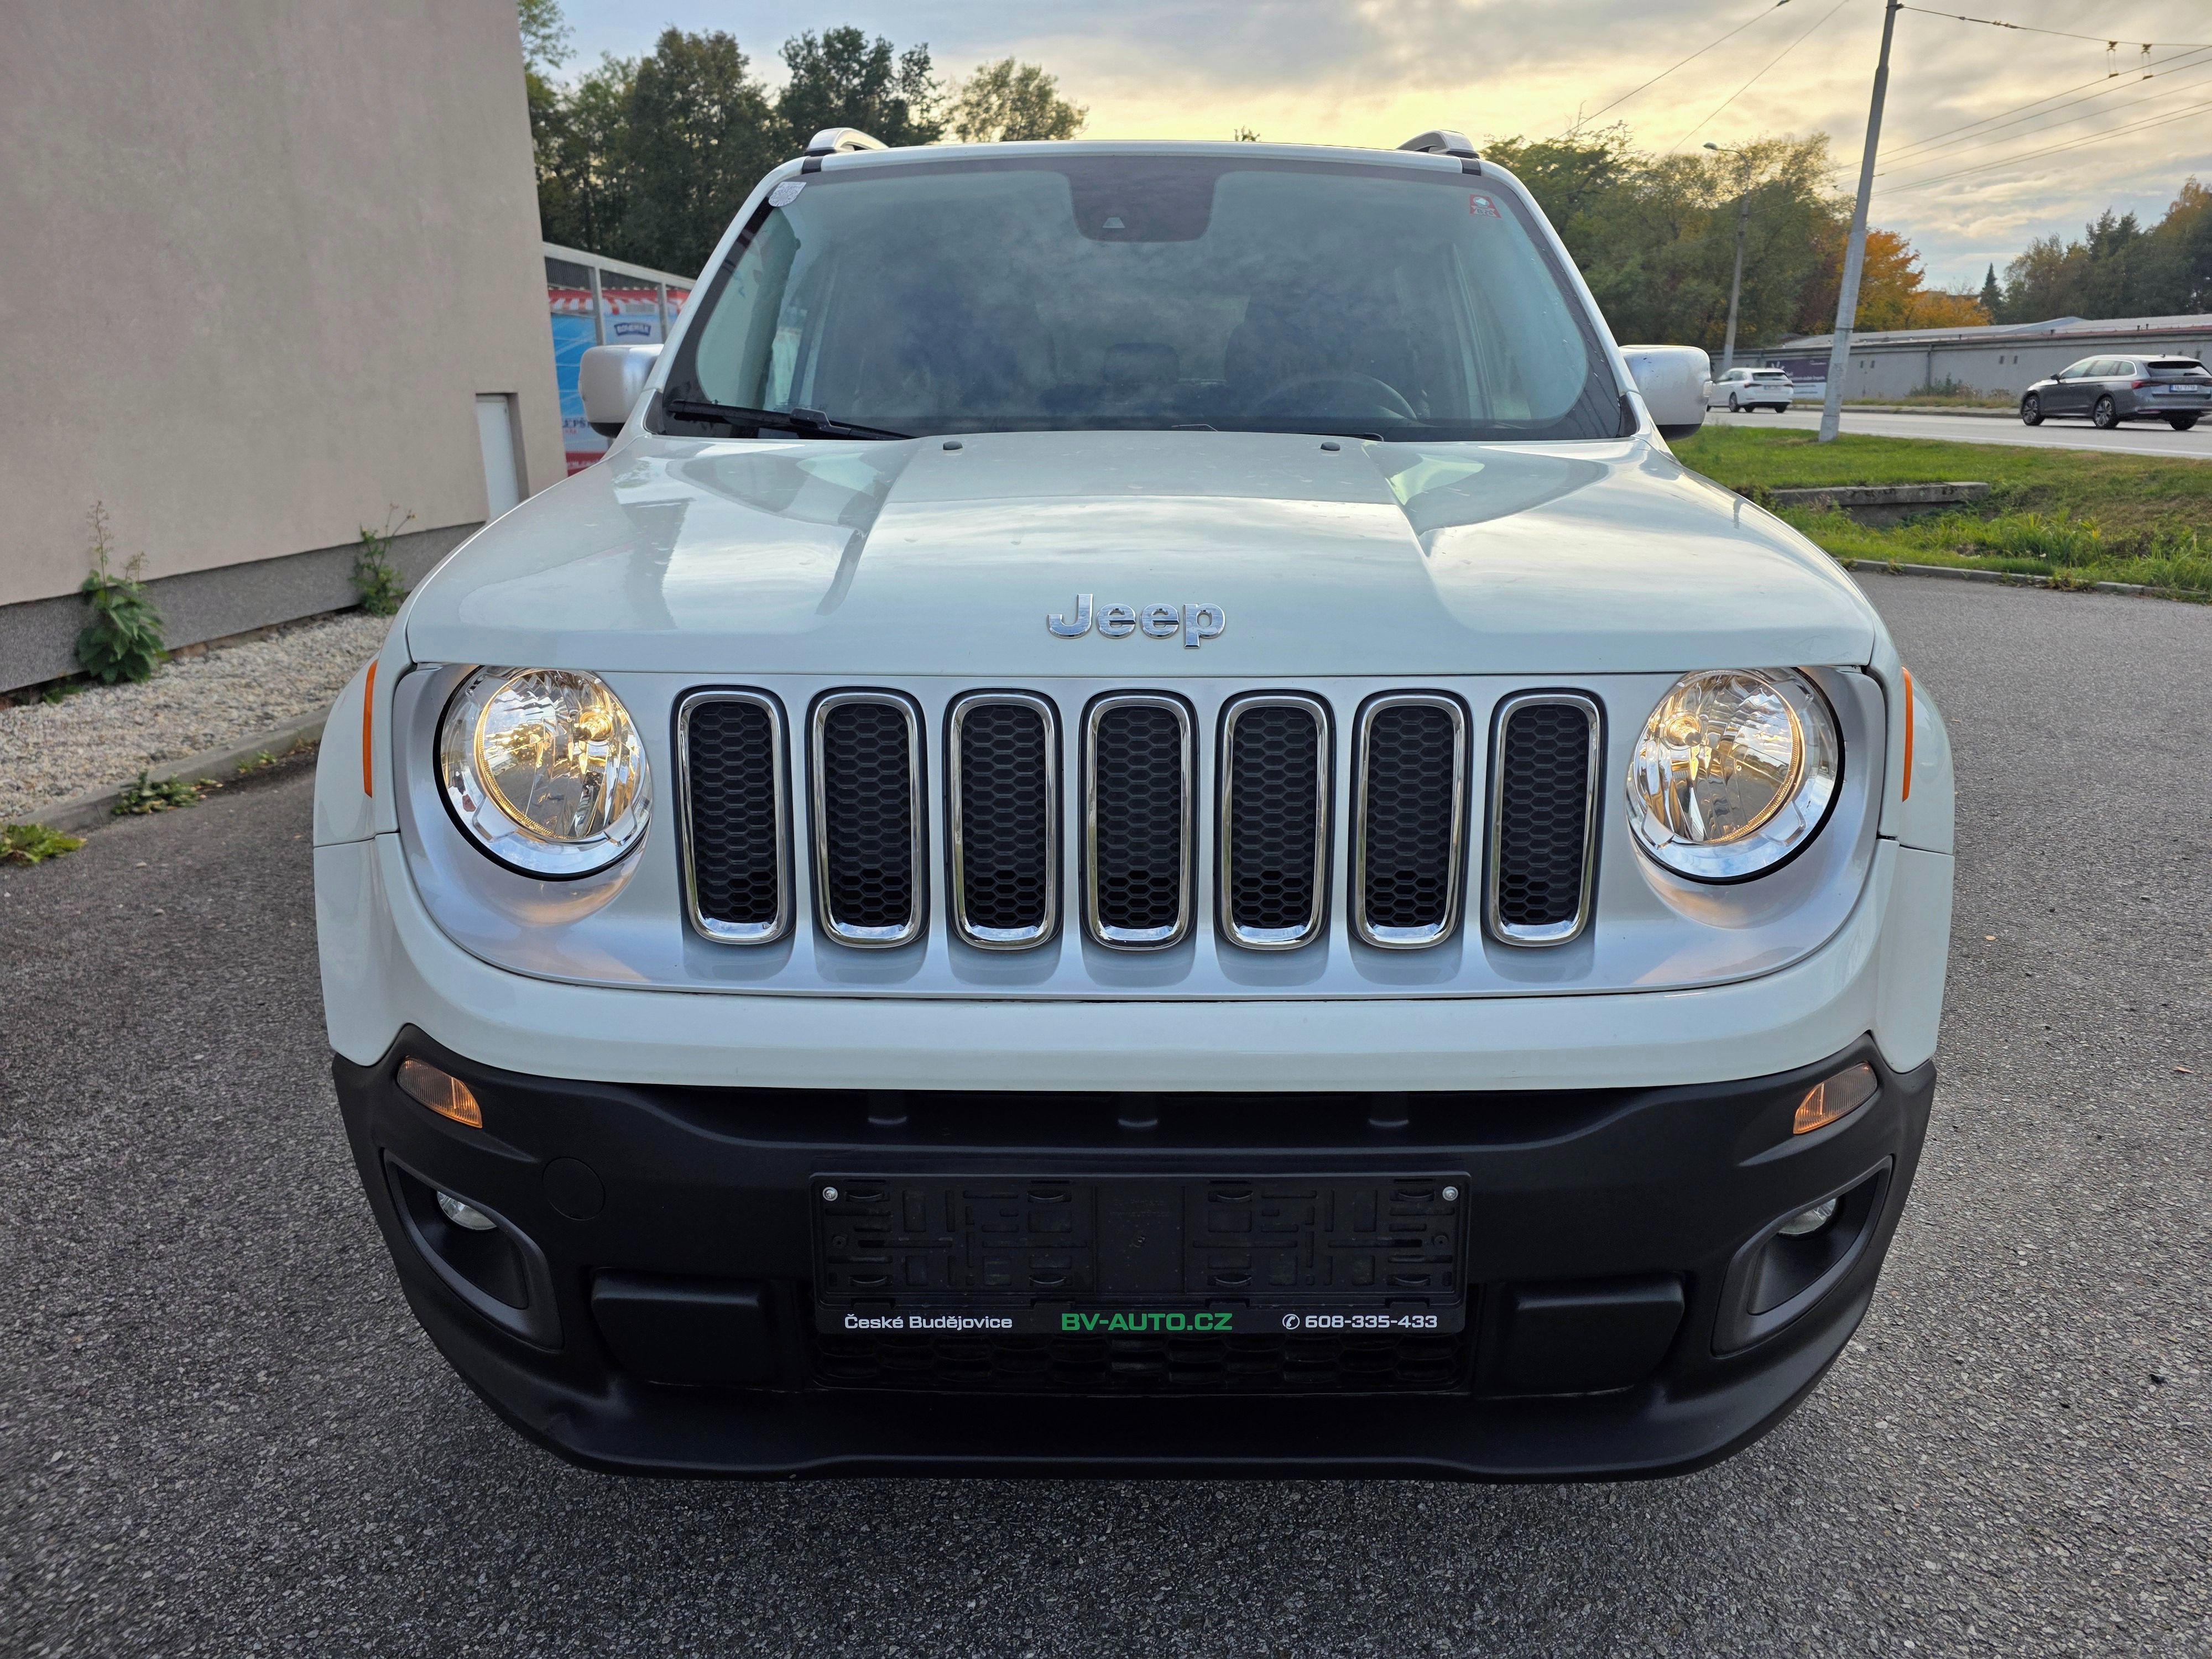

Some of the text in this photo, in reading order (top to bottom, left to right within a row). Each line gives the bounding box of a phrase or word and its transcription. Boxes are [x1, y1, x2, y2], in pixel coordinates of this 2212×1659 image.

[1047, 593, 1225, 649] Jeep
[845, 1313, 1437, 1331] České Budějovice BV-AUTO.CZ 608-335-433
